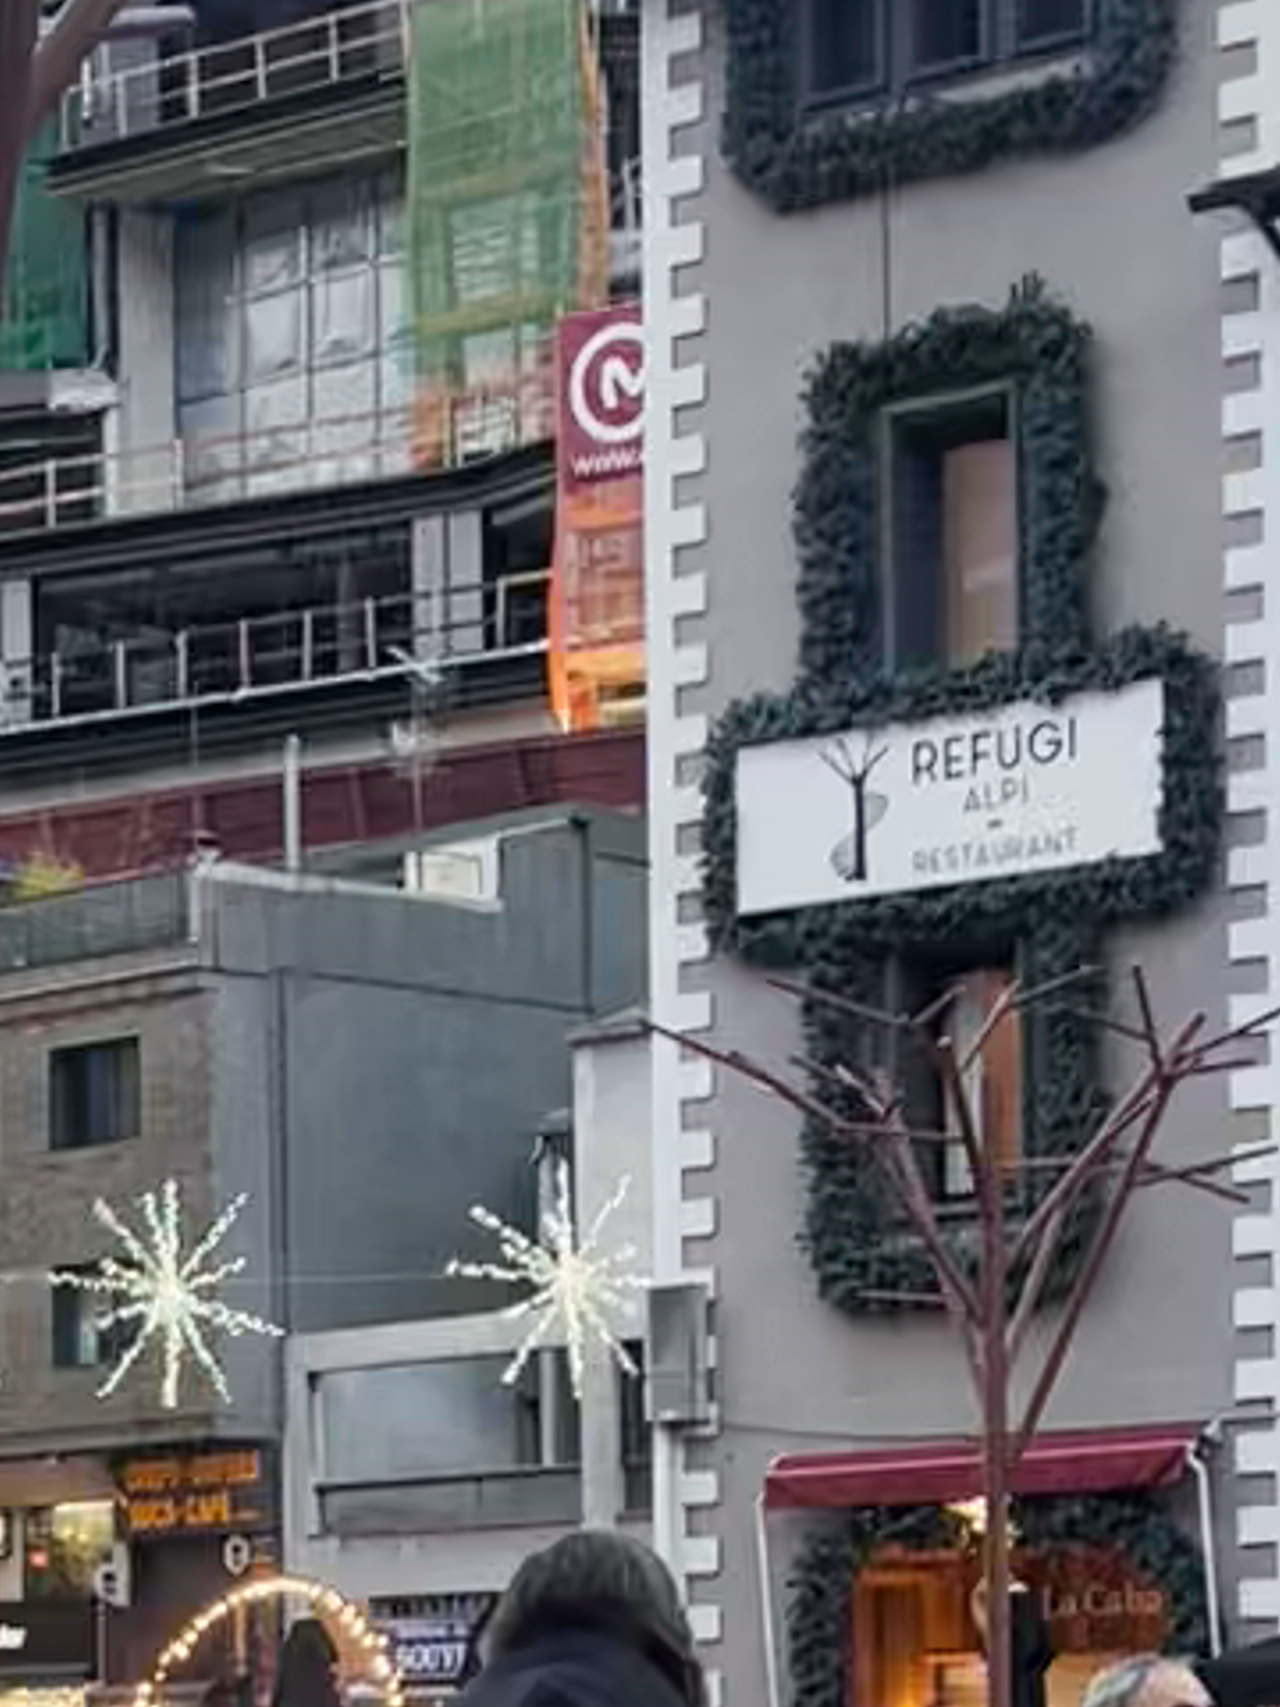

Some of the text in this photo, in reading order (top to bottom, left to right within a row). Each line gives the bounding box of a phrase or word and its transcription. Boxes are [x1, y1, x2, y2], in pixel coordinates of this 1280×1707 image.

[910, 717, 1078, 787] REFUGI
[963, 777, 1030, 815] ALPI
[911, 825, 1078, 874] RESTAURANT
